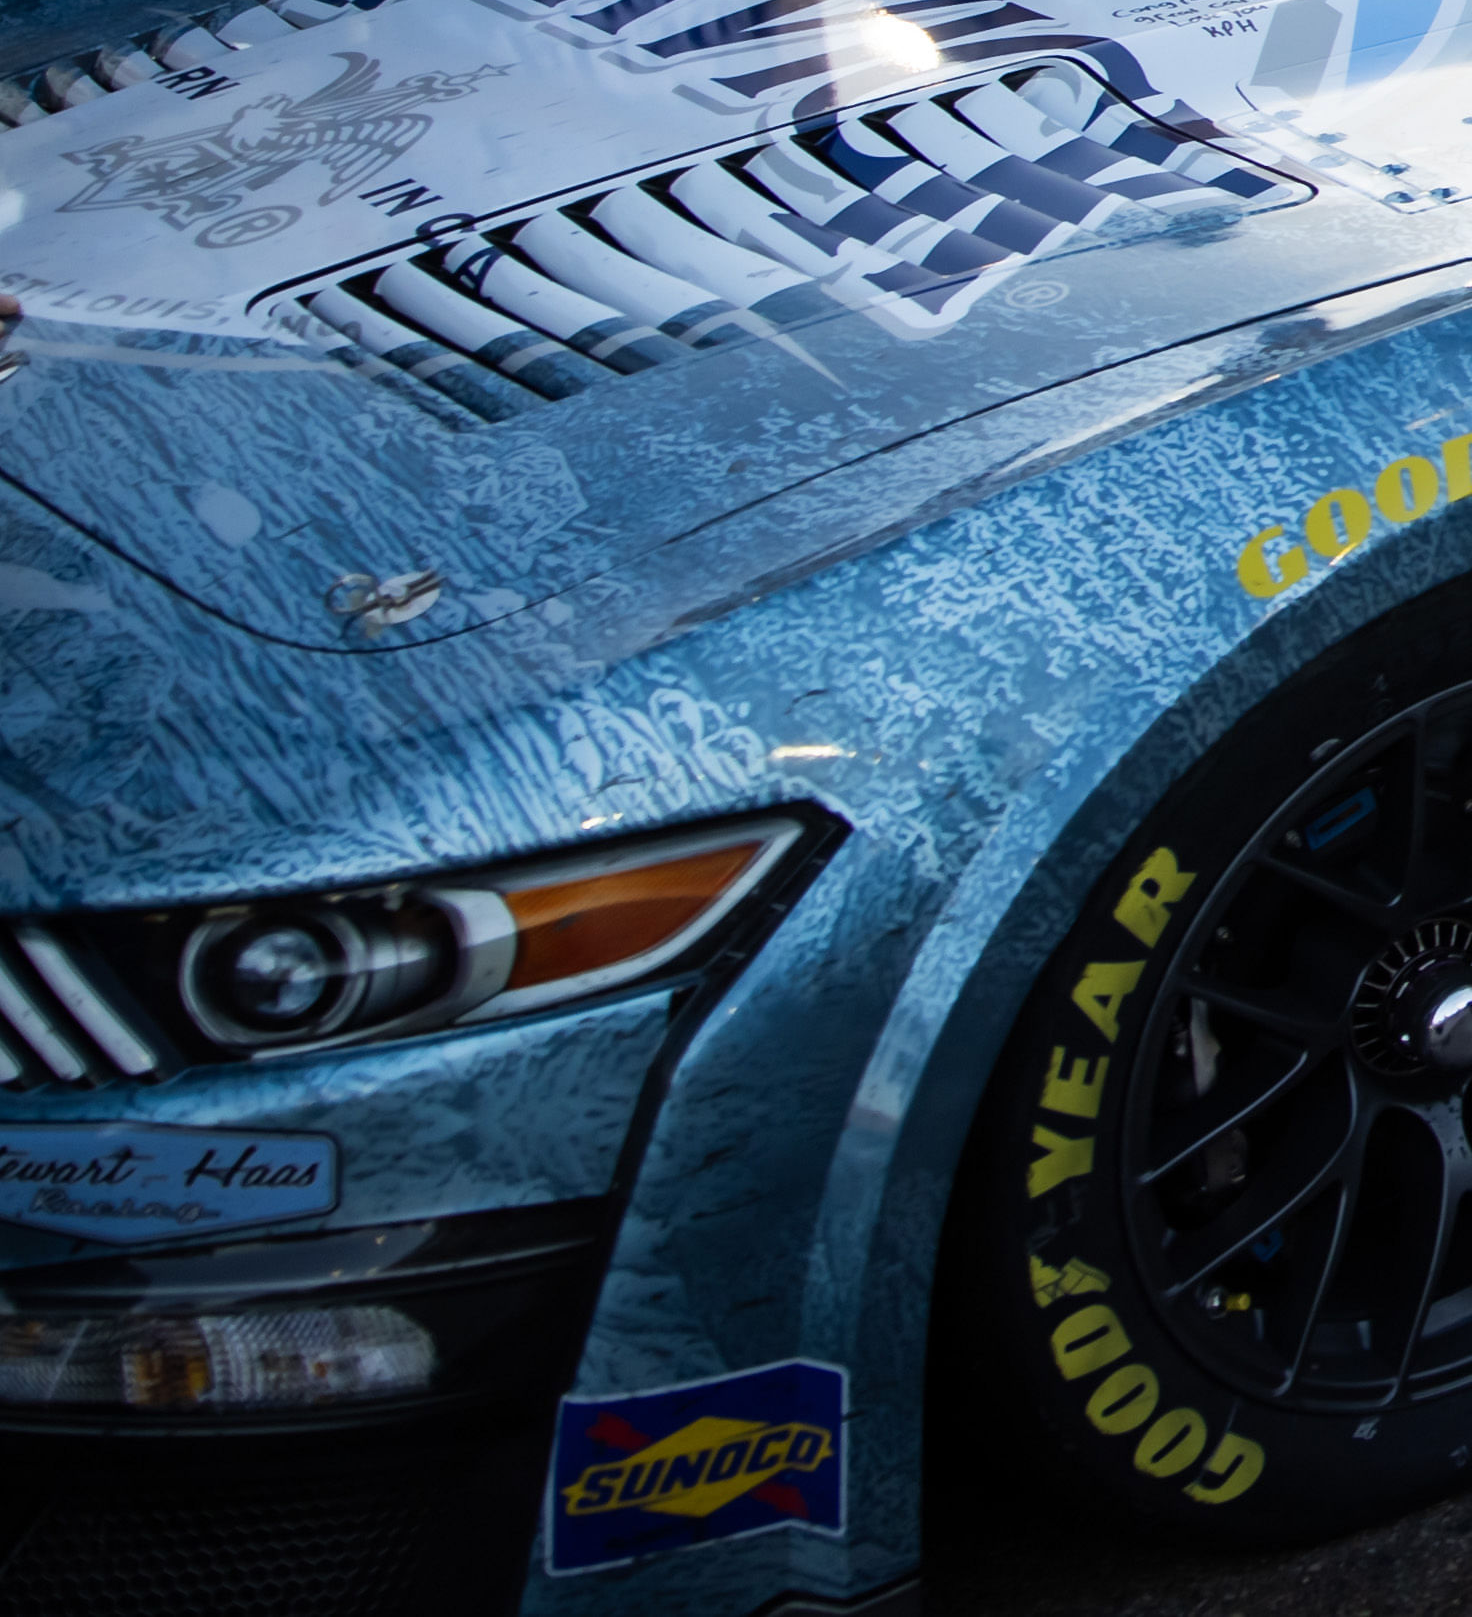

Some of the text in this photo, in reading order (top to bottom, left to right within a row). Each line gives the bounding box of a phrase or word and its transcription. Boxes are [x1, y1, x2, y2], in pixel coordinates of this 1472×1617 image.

[1134, 7, 1199, 25] great
[1202, 18, 1259, 38] KPH
[358, 178, 443, 218] IN
[66, 286, 232, 327] LOUIS,
[183, 1144, 325, 1191] Haas
[1026, 844, 1268, 1507] GOODYEAR
[575, 1416, 825, 1517] SUNOCO
